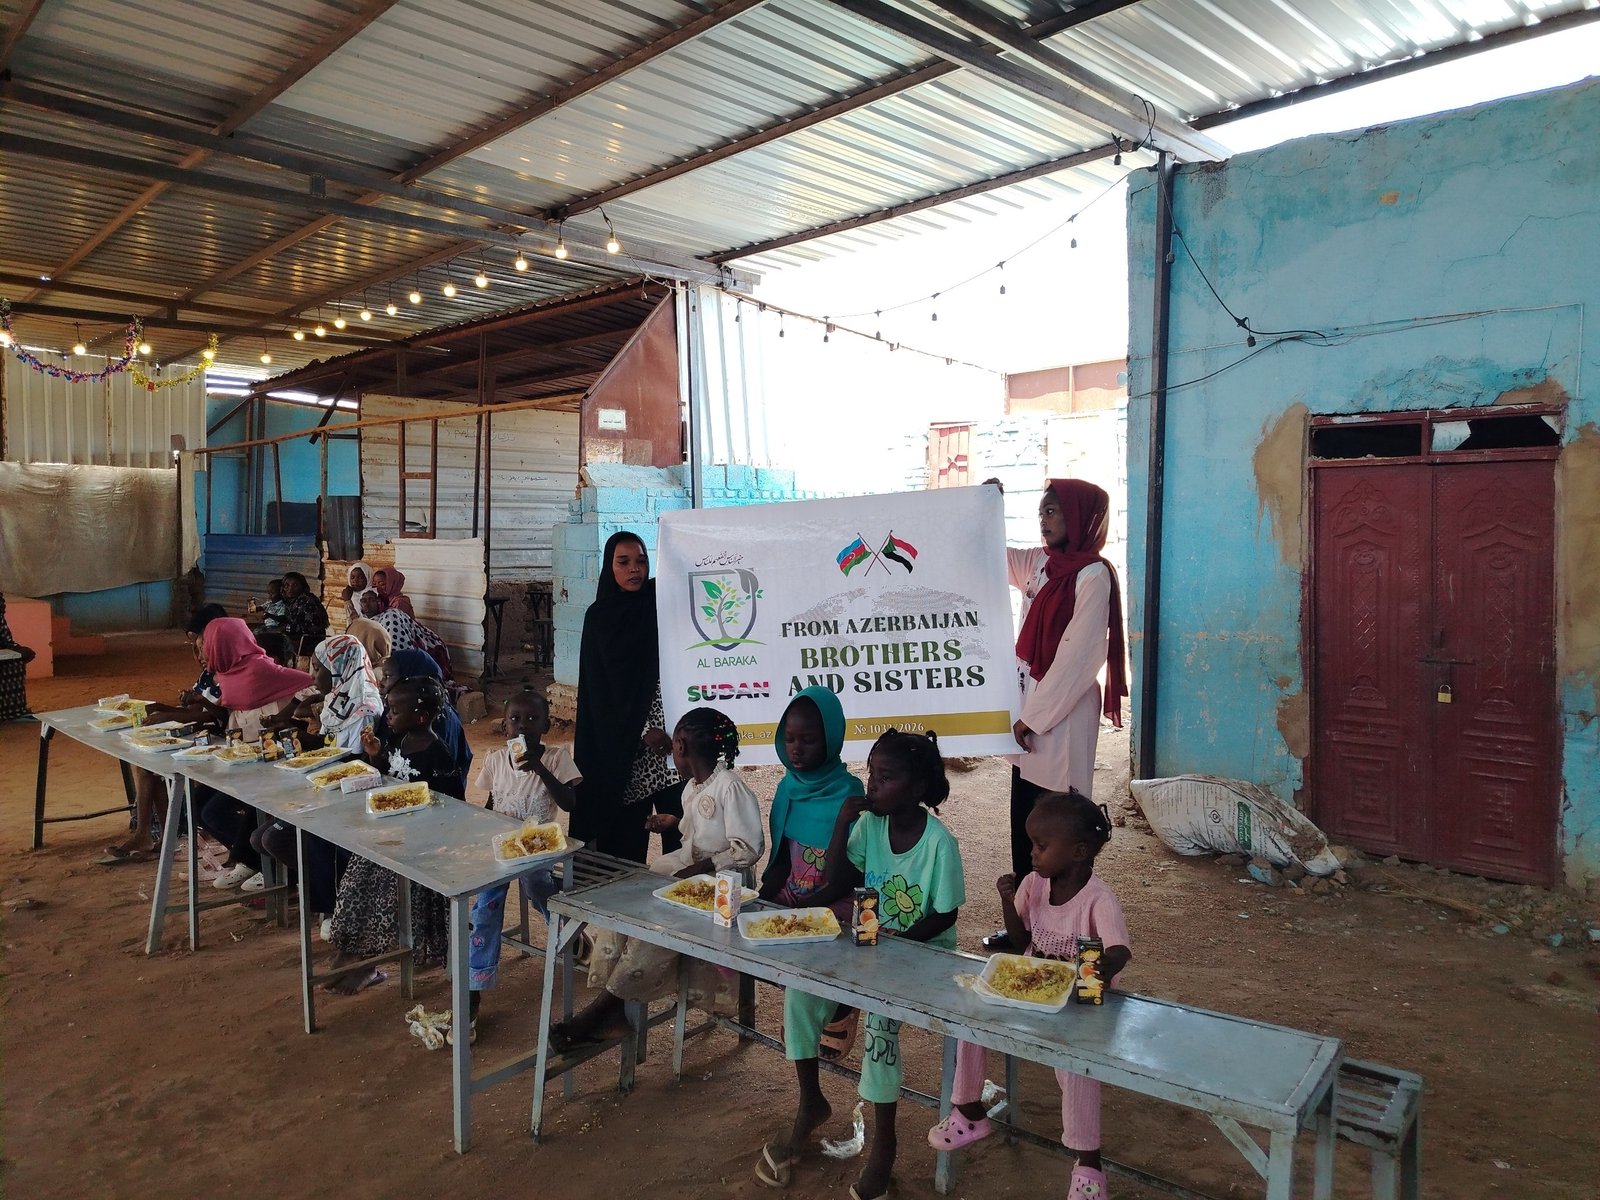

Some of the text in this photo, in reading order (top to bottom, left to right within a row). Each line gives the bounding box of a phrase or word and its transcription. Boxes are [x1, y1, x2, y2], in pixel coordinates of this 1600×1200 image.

[781, 611, 978, 638] FROM AZERBAIJAN
[697, 655, 757, 668] AL BARAKA
[800, 639, 962, 669] BROTHERS
[687, 681, 770, 702] SUDAN
[788, 665, 985, 696] AND SISTERS
